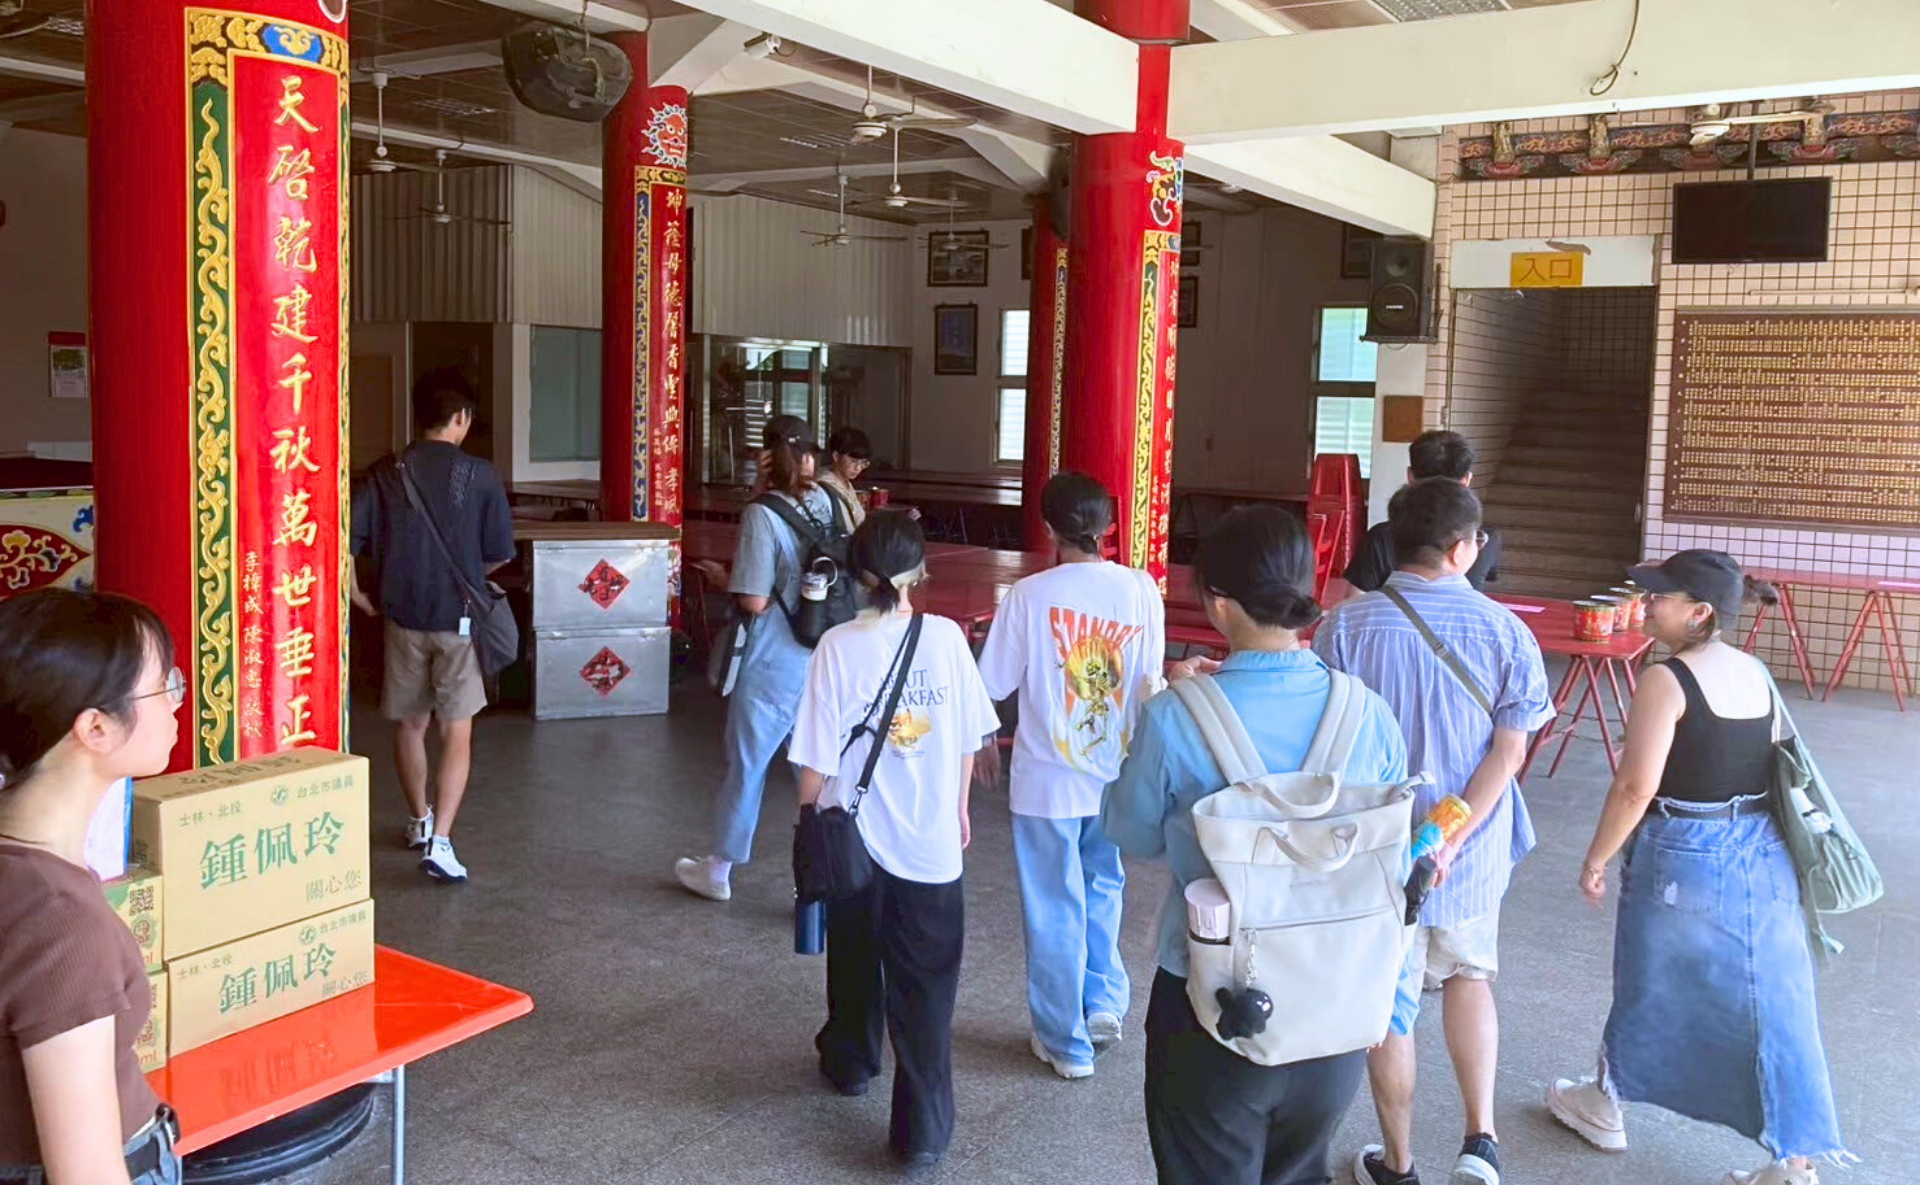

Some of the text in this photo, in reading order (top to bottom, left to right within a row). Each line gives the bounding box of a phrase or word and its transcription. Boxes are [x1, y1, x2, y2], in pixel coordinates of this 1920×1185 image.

[1519, 257, 1572, 282] 入口
[199, 811, 345, 890] 鍾佩玲
[219, 942, 337, 1015] 鍾佩玲
